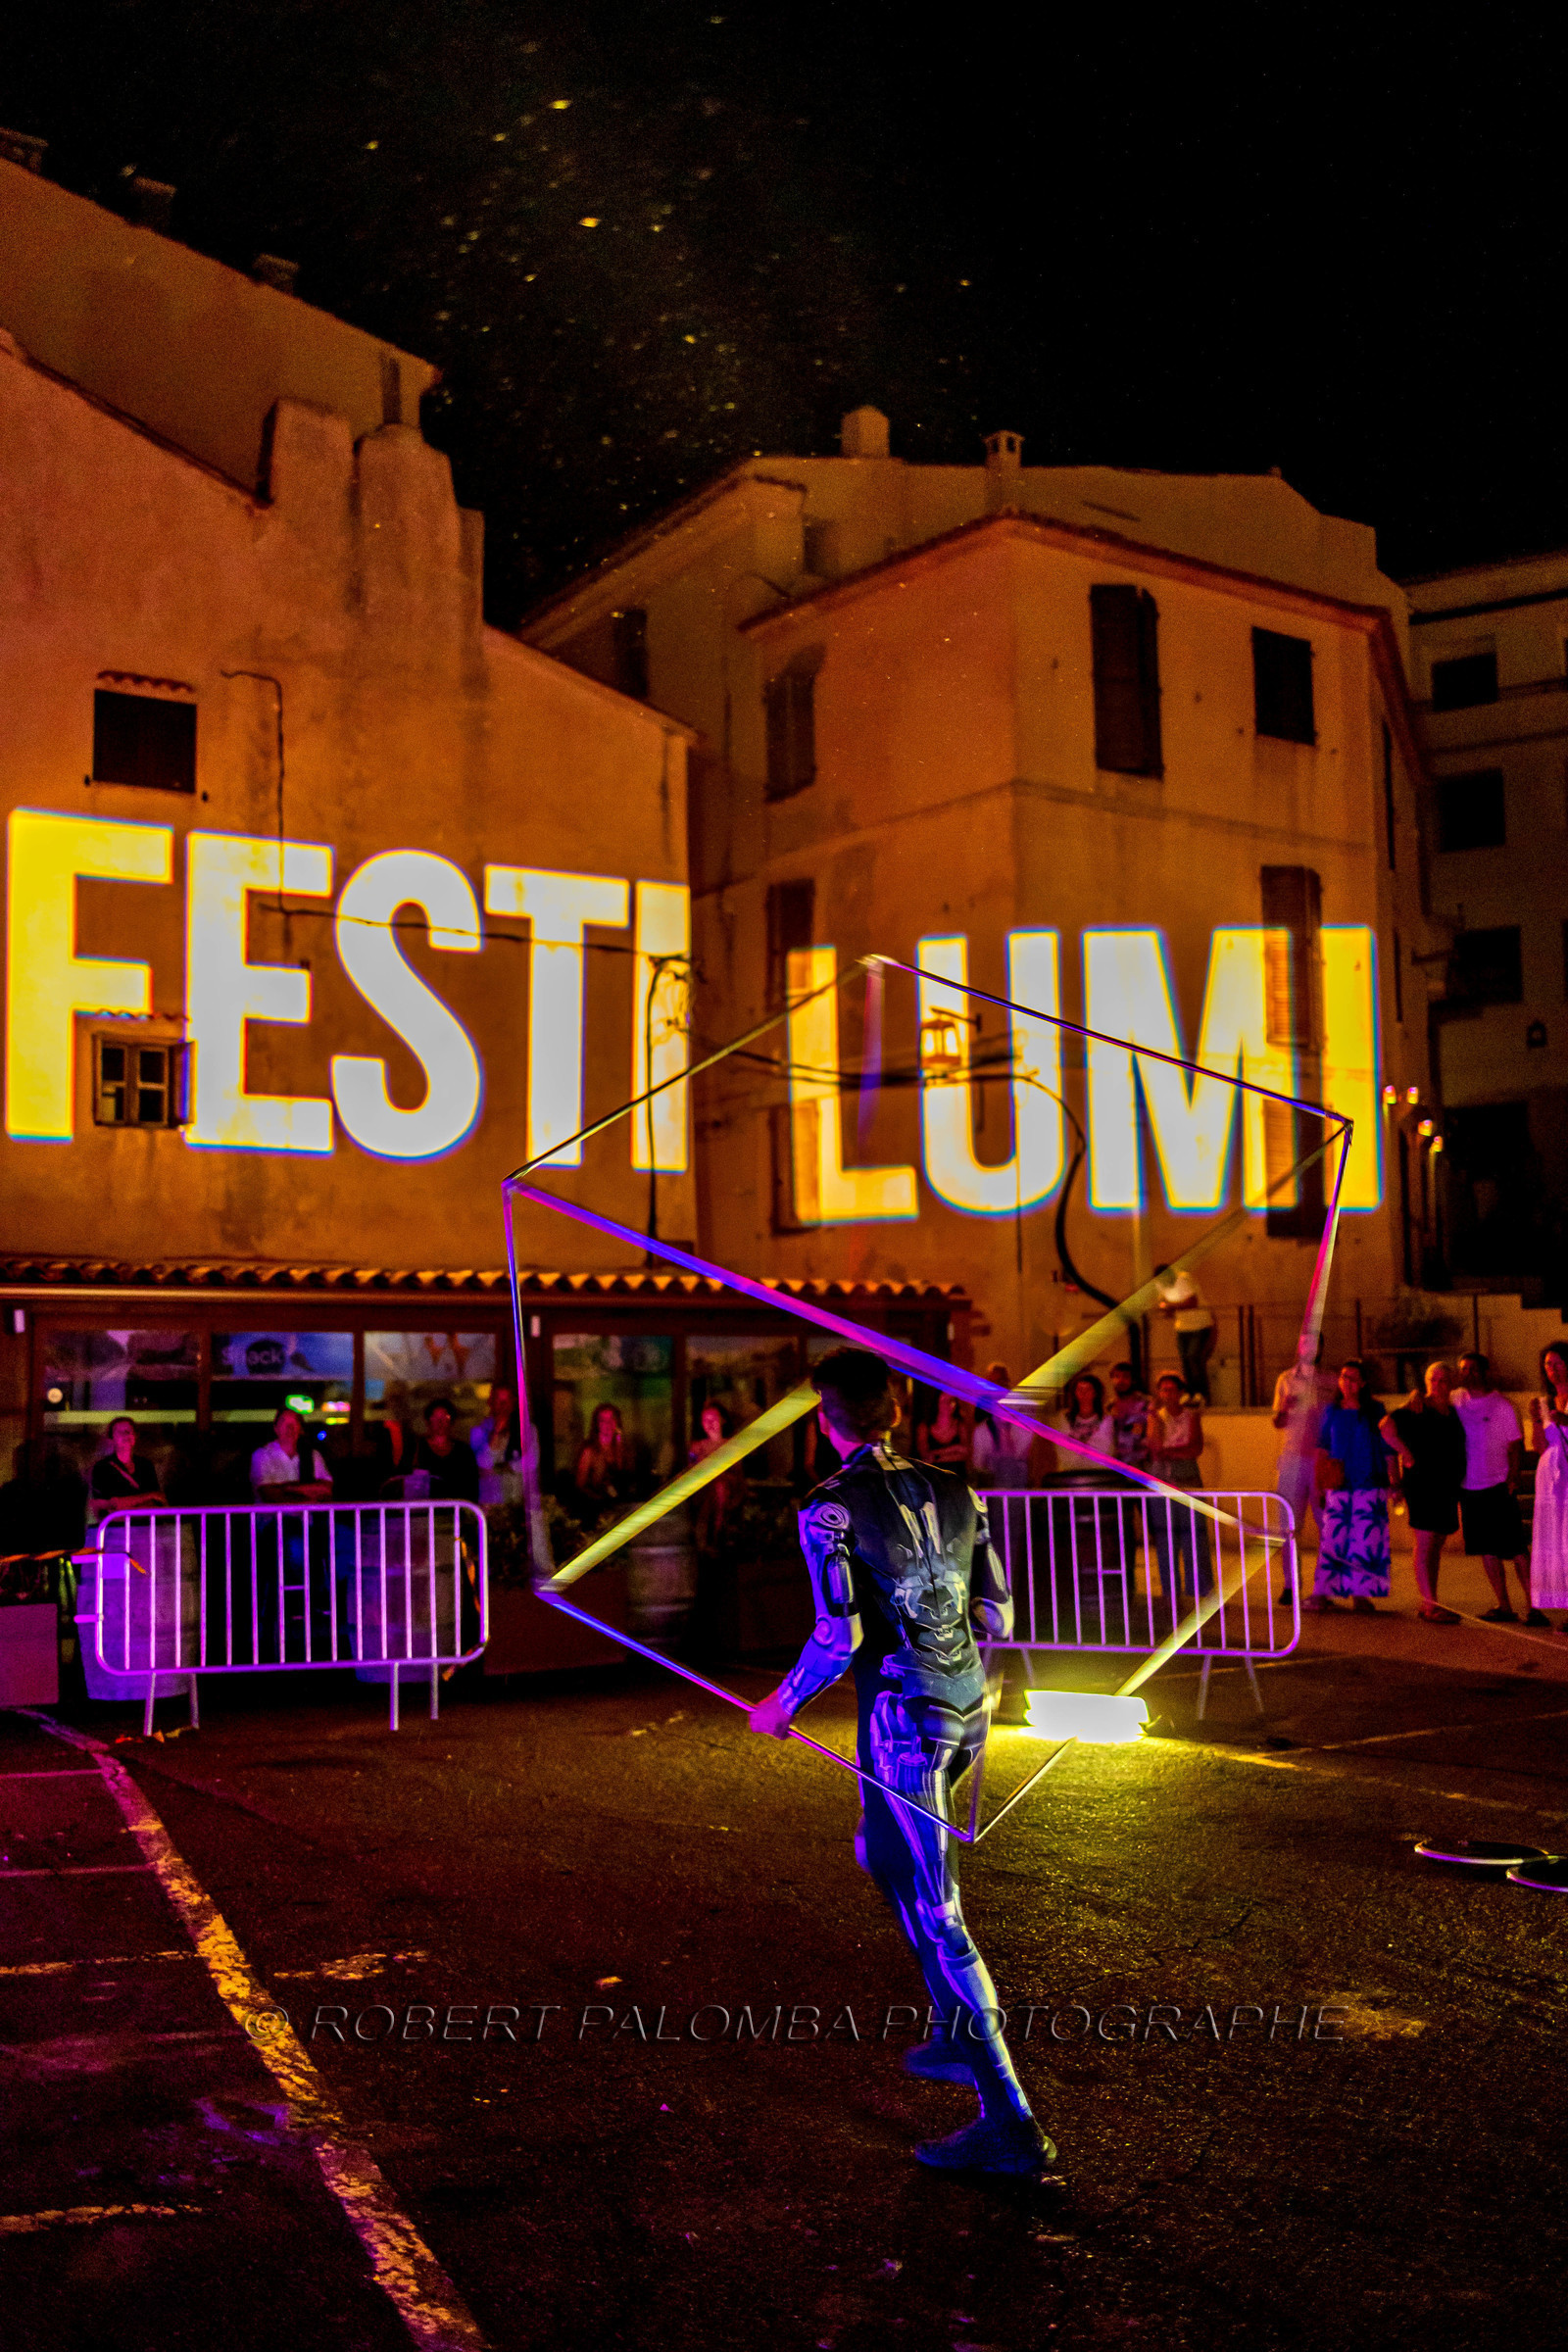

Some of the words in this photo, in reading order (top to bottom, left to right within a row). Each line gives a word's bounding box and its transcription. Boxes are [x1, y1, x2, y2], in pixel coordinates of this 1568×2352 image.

[5, 808, 692, 1173] FESTI
[787, 925, 1383, 1224] LUMI
[220, 1346, 284, 1367] Sack
